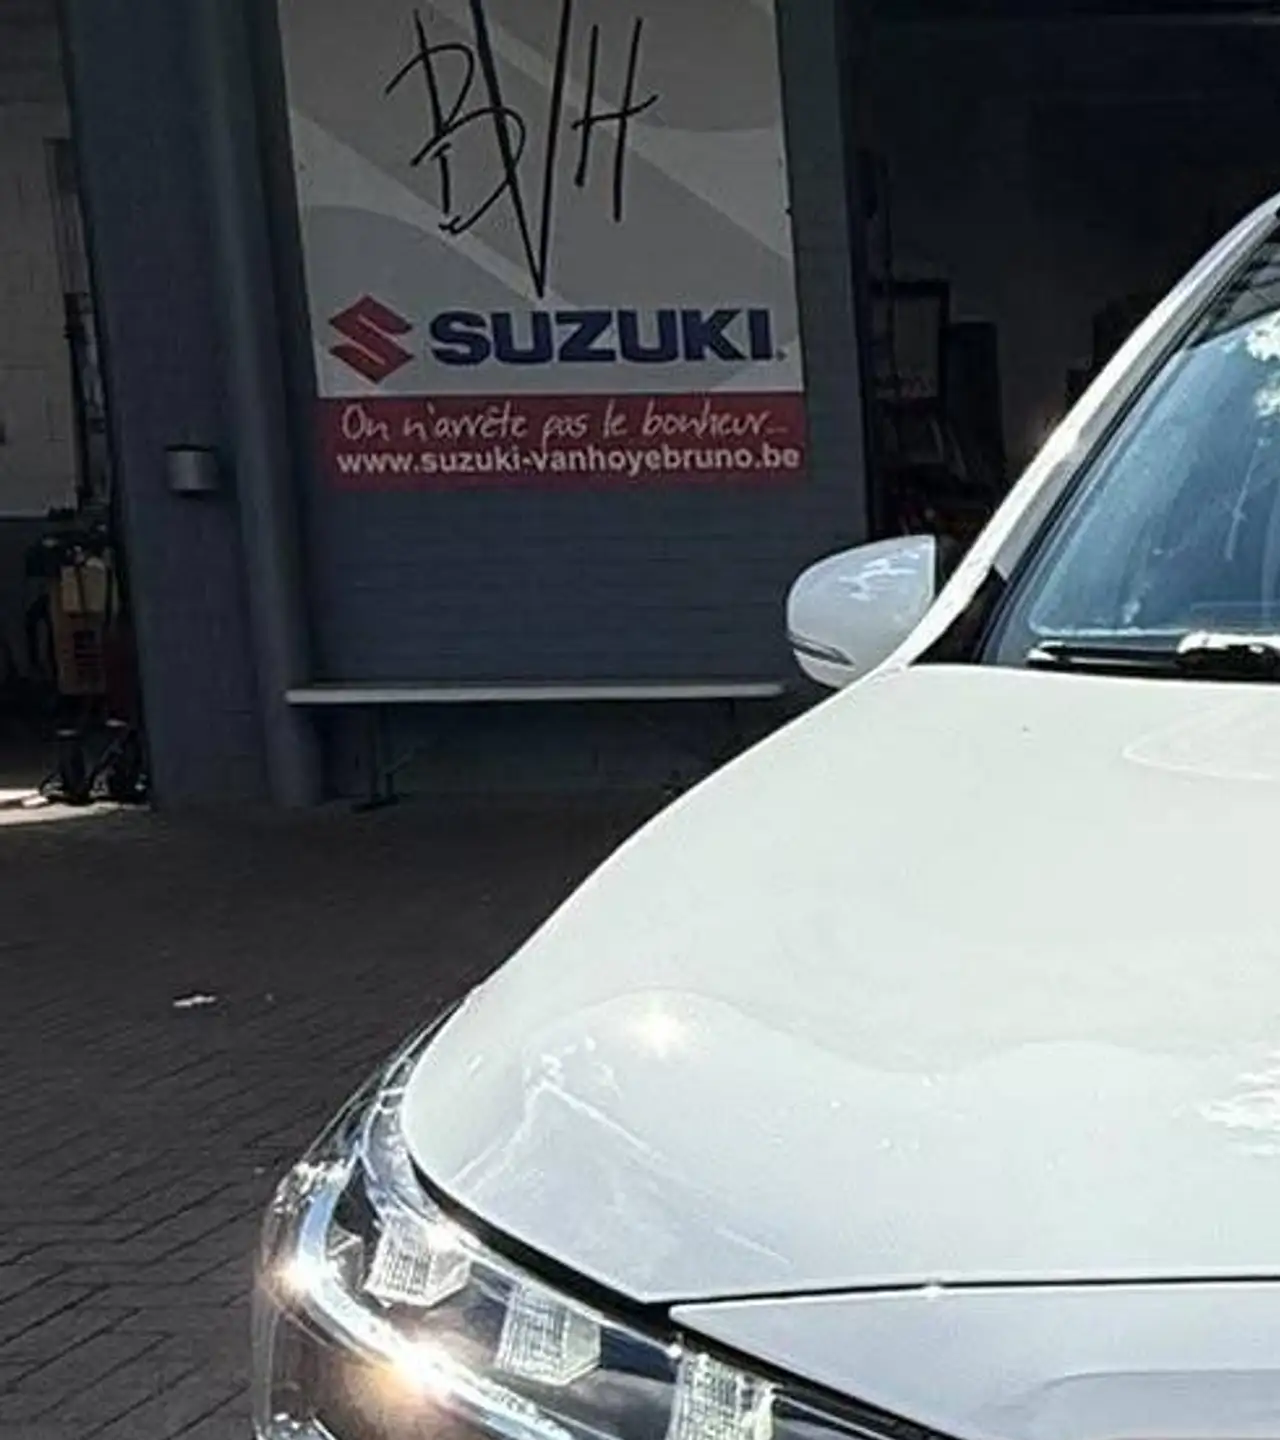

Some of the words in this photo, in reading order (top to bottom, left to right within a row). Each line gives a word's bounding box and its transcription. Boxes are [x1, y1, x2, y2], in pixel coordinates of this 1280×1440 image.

[429, 308, 774, 366] SUZUKI
[340, 402, 391, 441] On
[542, 412, 589, 450] pas
[602, 400, 630, 440] le
[336, 444, 801, 478] www.suzuki-vanhoyebruno.be
